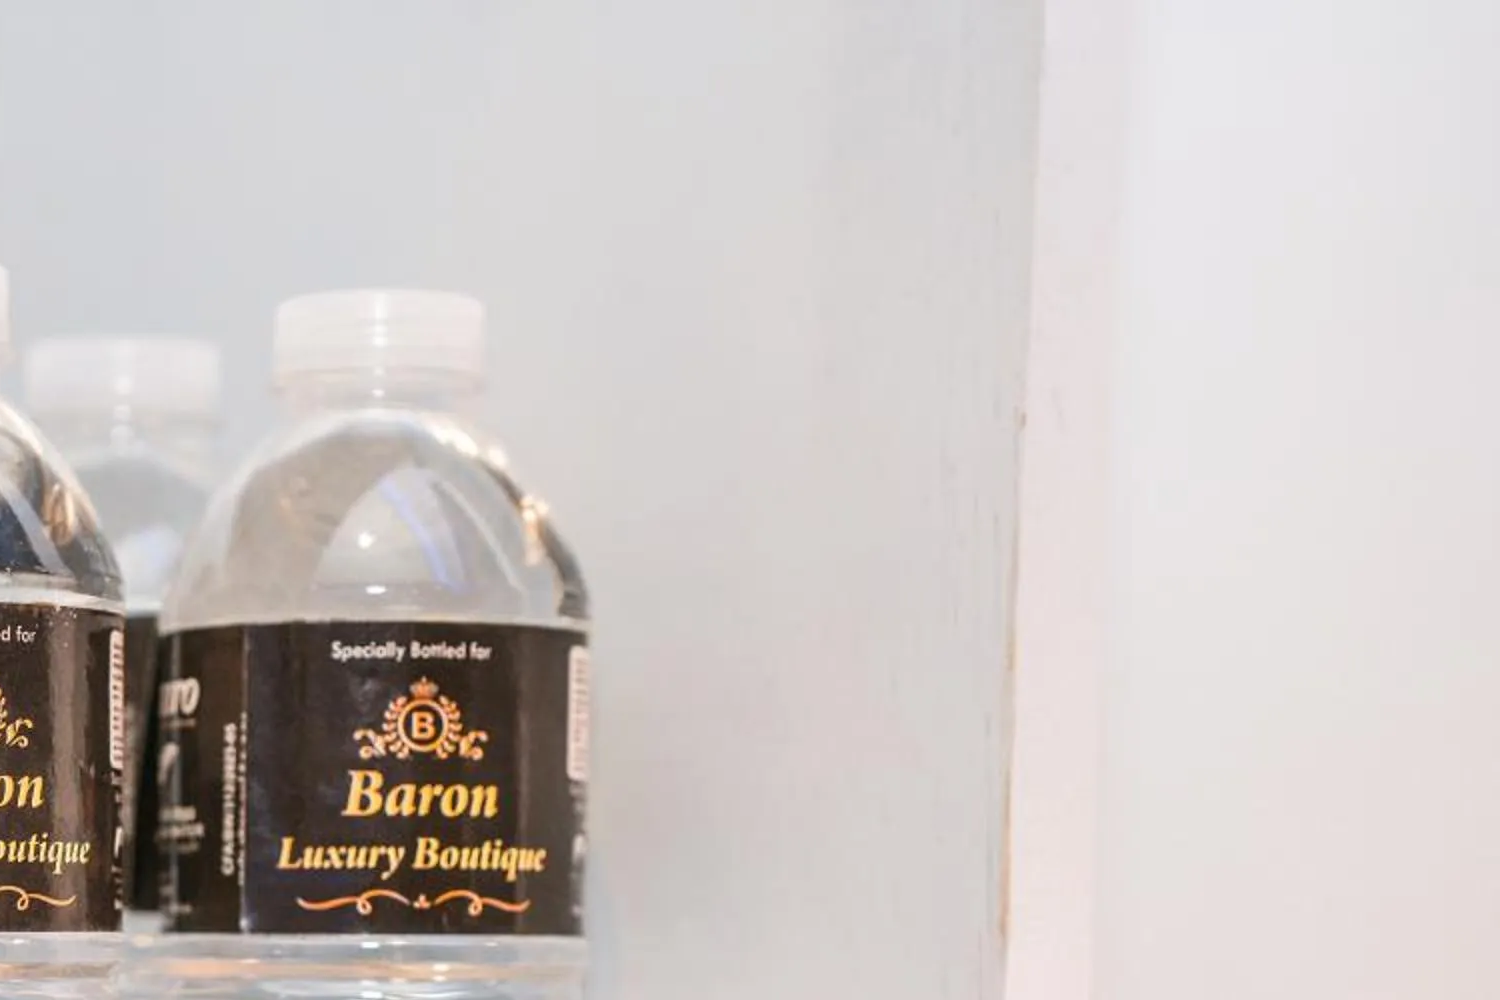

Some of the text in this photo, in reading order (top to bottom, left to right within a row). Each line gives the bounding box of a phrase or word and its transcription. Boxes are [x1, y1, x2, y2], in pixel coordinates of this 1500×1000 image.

[16, 624, 37, 642] for
[332, 641, 491, 662] Specially Bottled for
[411, 711, 436, 739] B
[341, 770, 498, 818] Baron
[277, 837, 547, 882] Luxury Boutique
